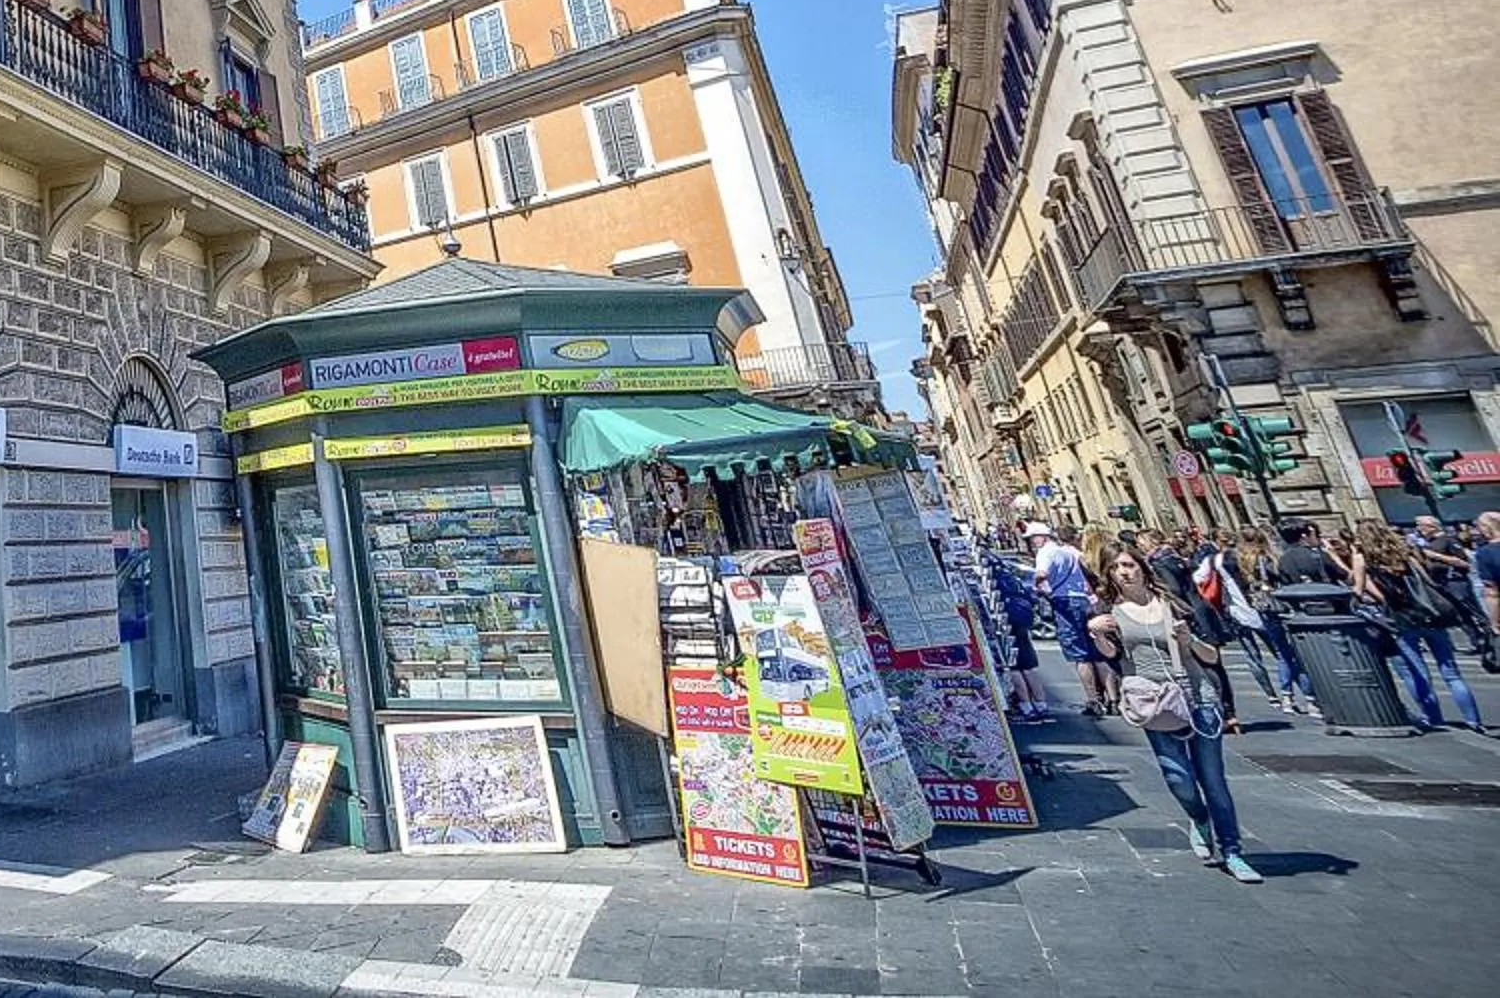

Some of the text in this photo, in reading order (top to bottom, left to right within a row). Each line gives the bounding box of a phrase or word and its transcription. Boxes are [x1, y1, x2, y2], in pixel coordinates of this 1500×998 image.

[316, 356, 414, 383] RIGAMONTI
[127, 446, 181, 465] Deutsche Bank
[924, 784, 979, 802] KETS
[987, 809, 1028, 823] HERE
[713, 836, 775, 858] TICKETS
